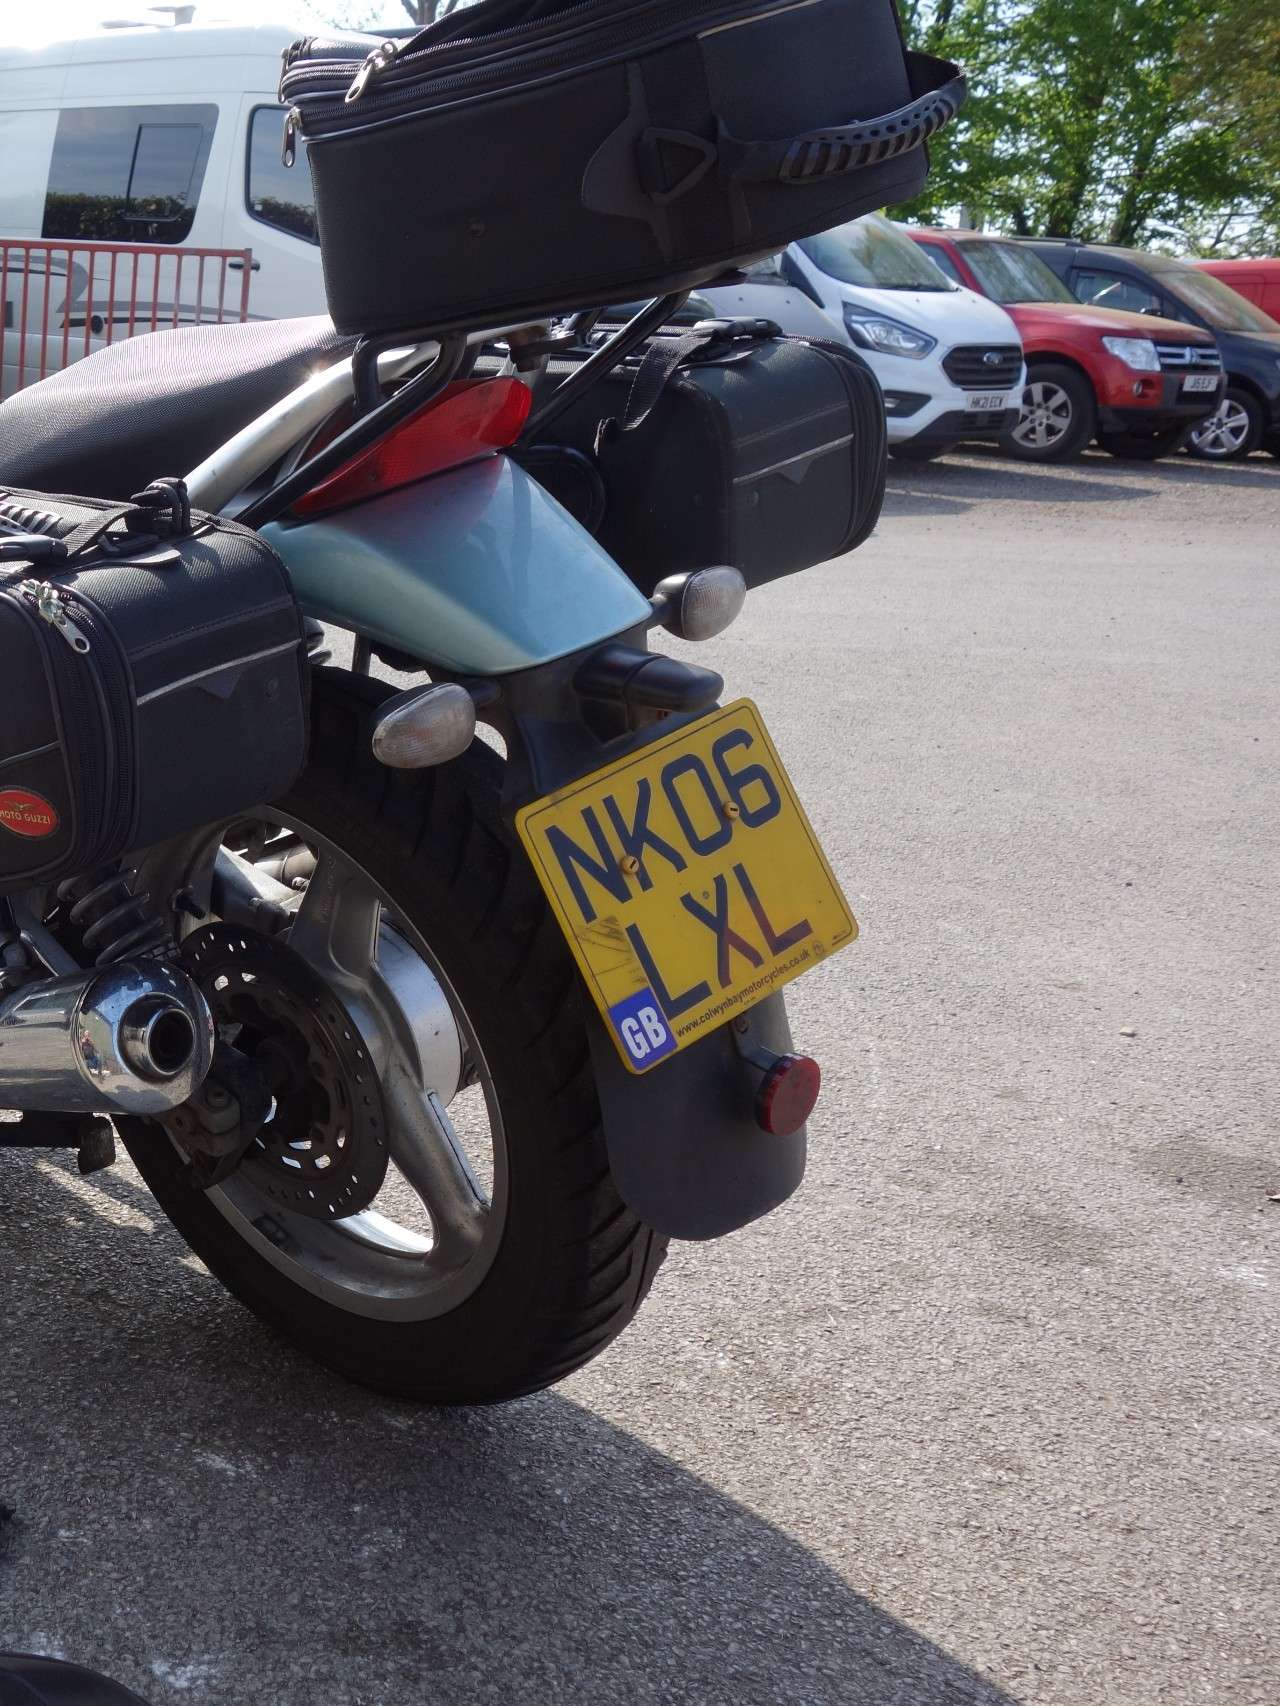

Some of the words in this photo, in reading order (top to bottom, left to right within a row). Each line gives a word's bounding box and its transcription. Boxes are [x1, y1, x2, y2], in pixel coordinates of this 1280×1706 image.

[0, 809, 22, 821] MOTO
[24, 813, 51, 825] GUZZI
[544, 728, 782, 924] NK06
[625, 863, 813, 1020] LXL
[621, 1006, 667, 1059] GB
[675, 949, 811, 1038] www.colwynbaymotorcycles.co.uk
